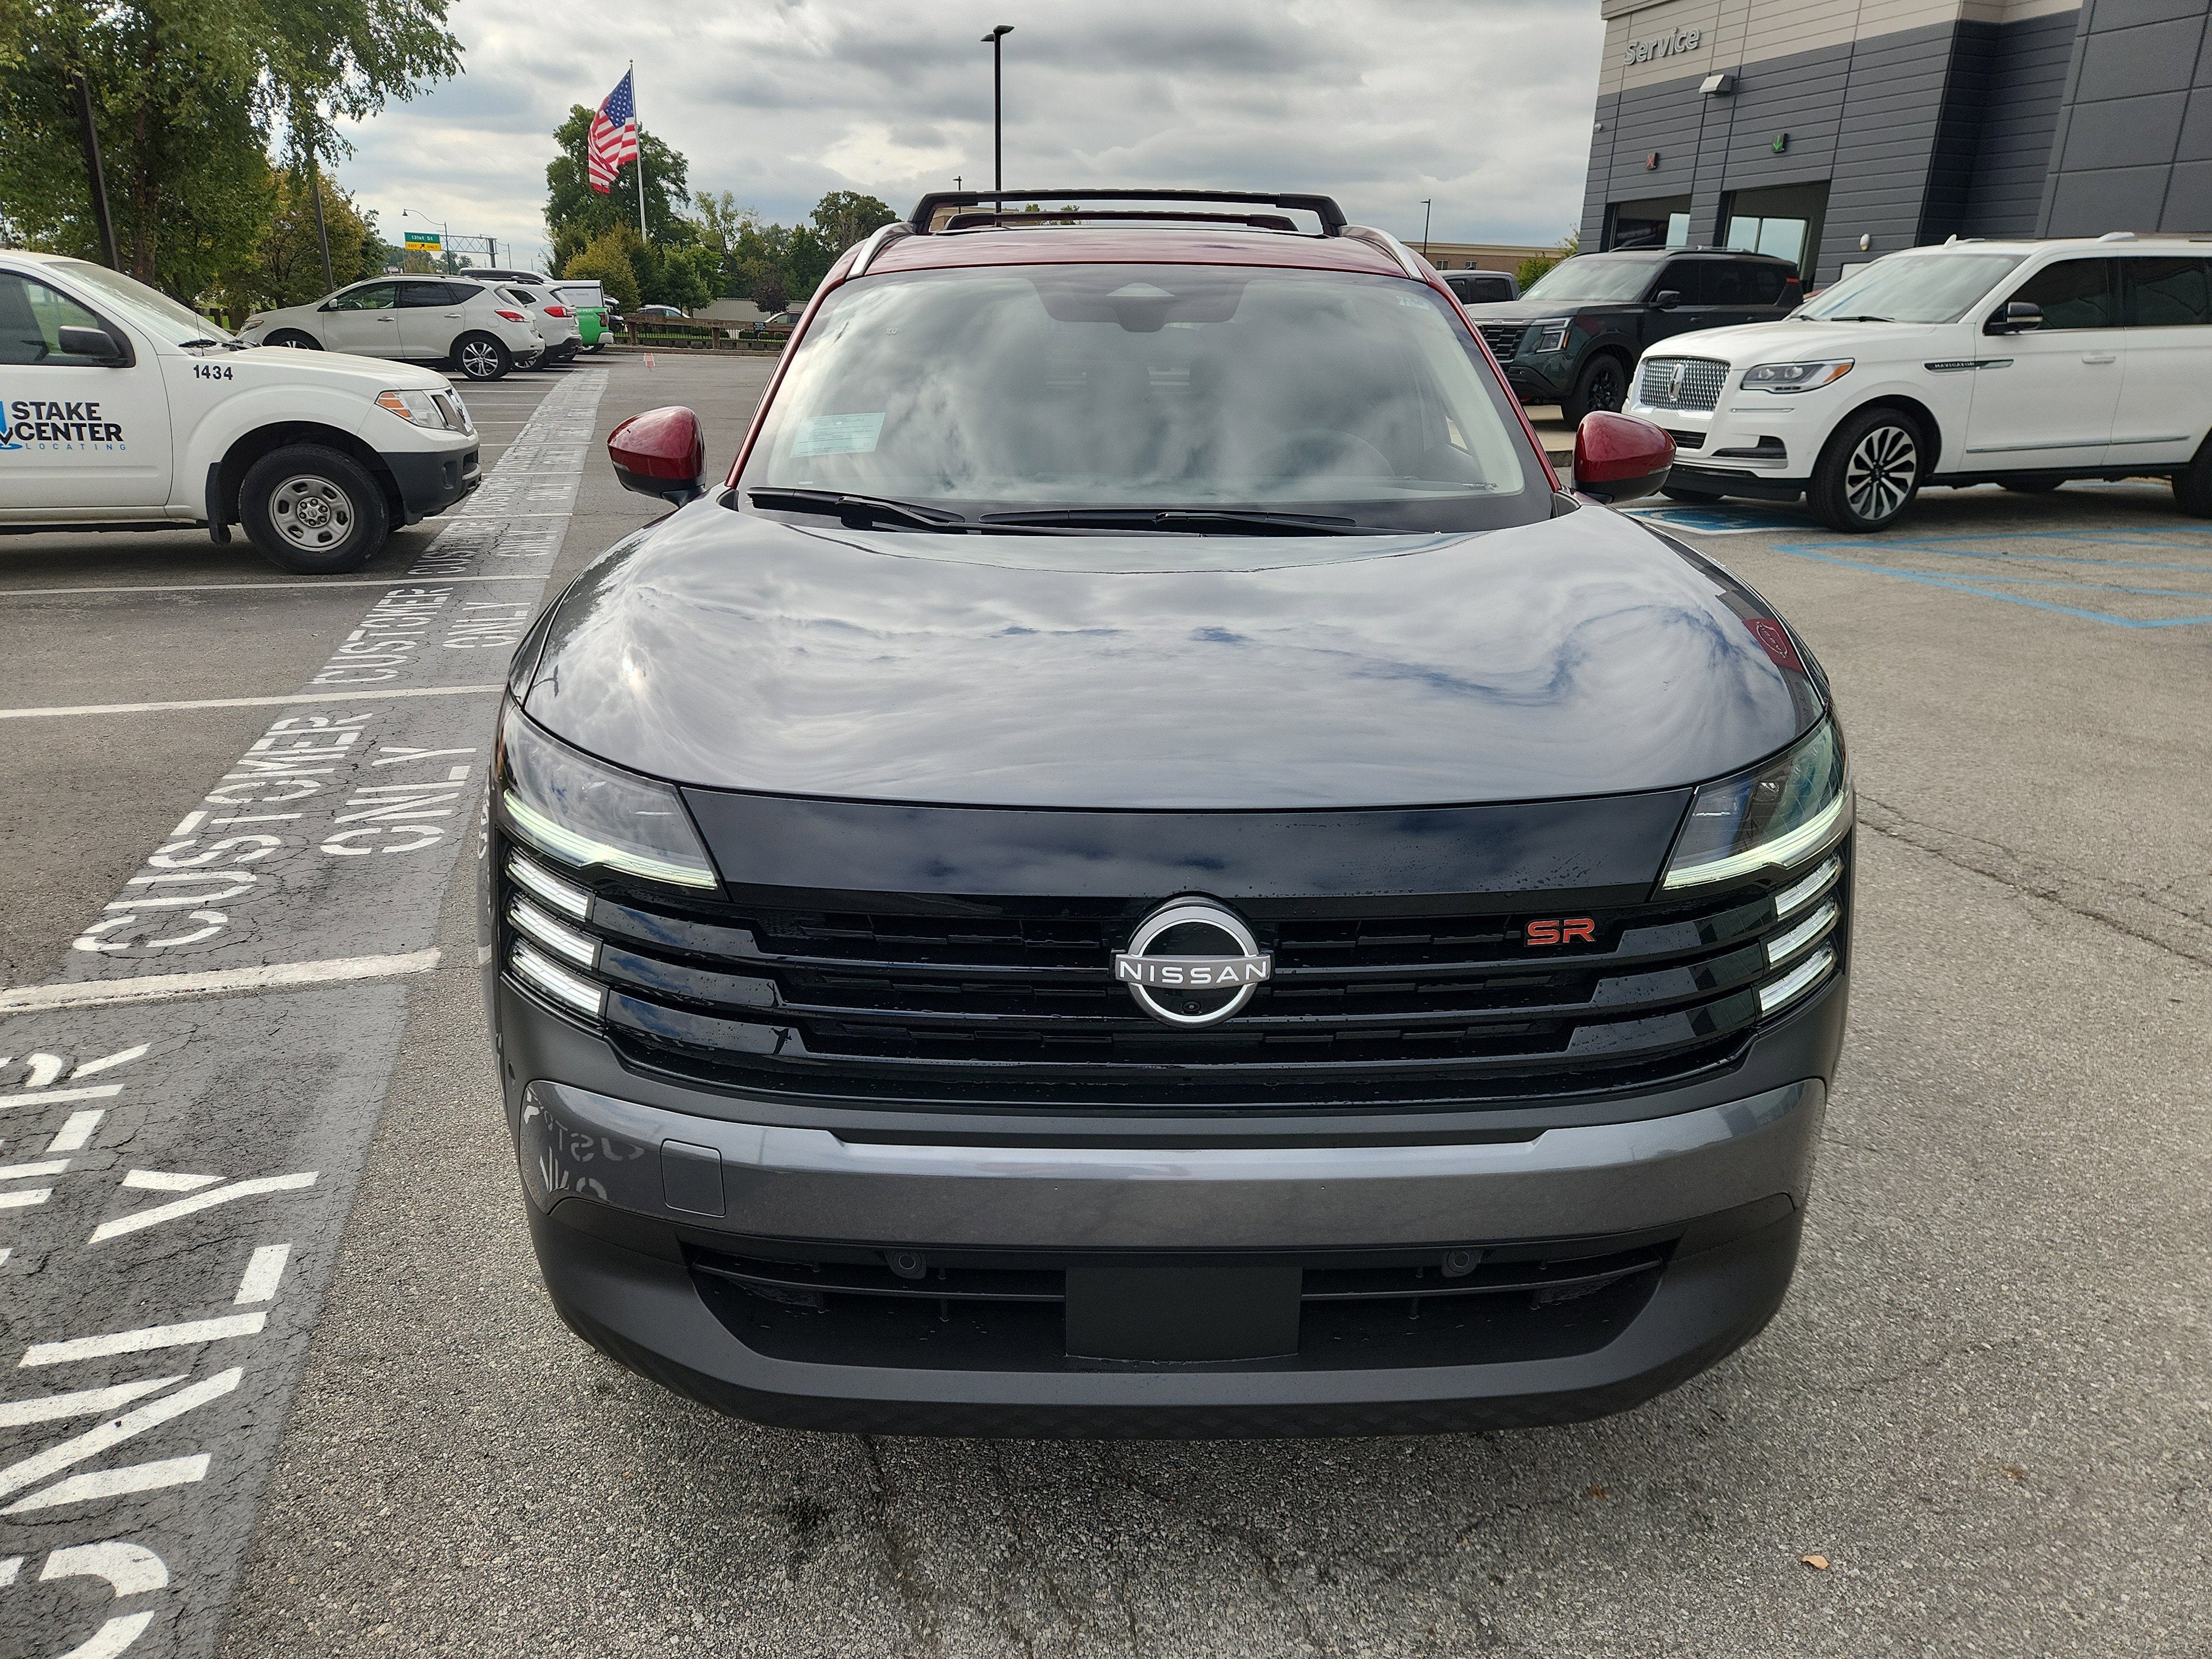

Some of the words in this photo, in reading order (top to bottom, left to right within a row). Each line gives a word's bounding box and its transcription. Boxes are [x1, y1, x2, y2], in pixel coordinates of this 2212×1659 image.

[1624, 27, 1700, 65] Service
[193, 364, 233, 381] 1434
[11, 401, 102, 421] STAKE
[14, 422, 124, 442] CENTER
[496, 530, 557, 557] ONLY
[305, 587, 454, 684] CUSTOMER
[442, 602, 531, 648] ONLY
[320, 747, 477, 856] ONLY
[72, 713, 373, 952] CUSTOMER
[1526, 918, 1596, 946] SR
[1119, 959, 1268, 985] NISSAN
